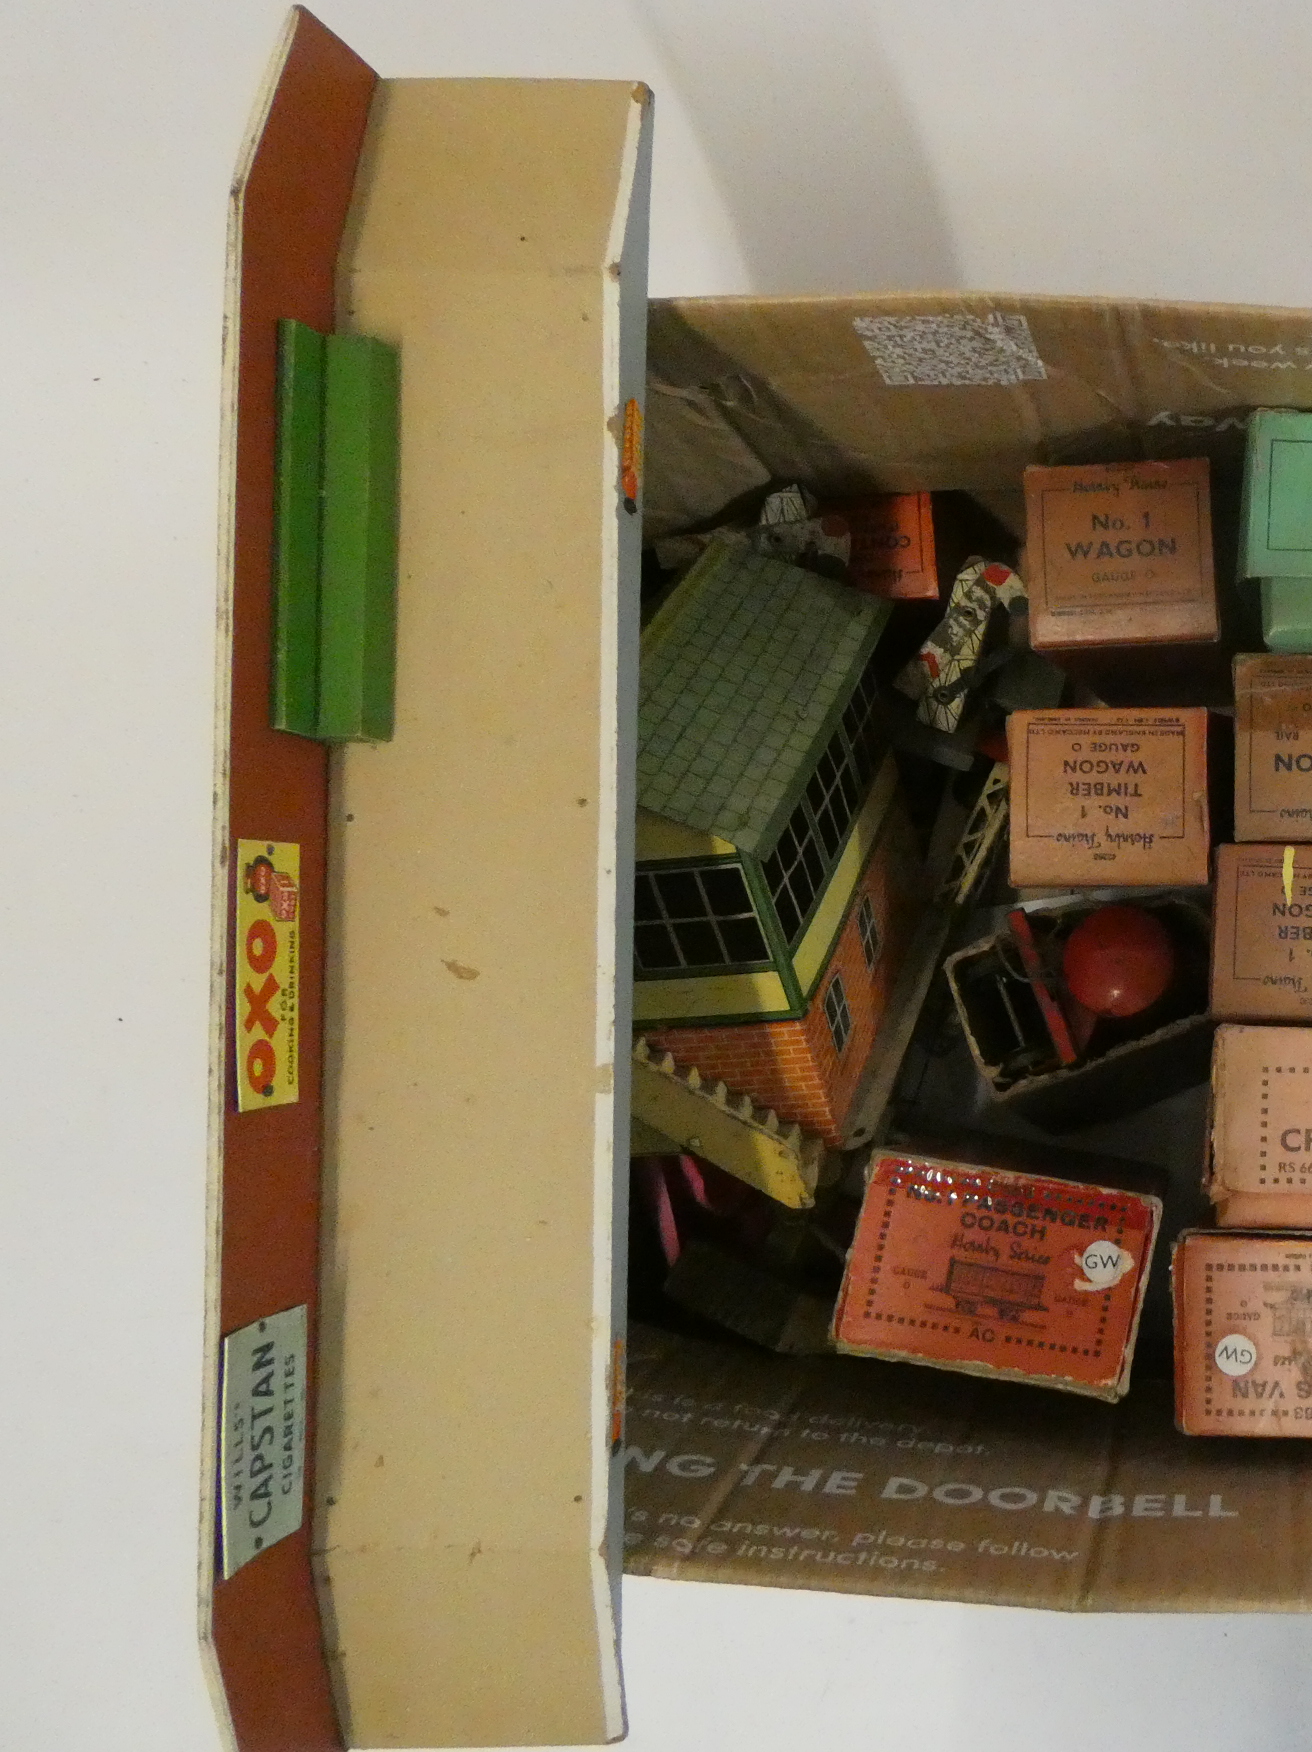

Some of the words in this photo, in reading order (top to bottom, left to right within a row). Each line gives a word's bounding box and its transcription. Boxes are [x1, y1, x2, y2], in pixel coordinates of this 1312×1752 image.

[1152, 339, 1217, 356] like.
[1228, 342, 1285, 358] you
[1205, 357, 1297, 371] week.
[1091, 513, 1131, 531] No.
[1142, 511, 1150, 529] 1
[1064, 537, 1178, 561] WAGON
[1089, 742, 1140, 753] GAUGE
[1063, 759, 1148, 775] WAGON
[1068, 781, 1143, 797] TIMBER
[1080, 805, 1087, 819] 1
[1098, 804, 1130, 820] No.
[1055, 832, 1102, 849] Trains
[1105, 825, 1155, 851] Hornby
[287, 930, 295, 999] DRINKING
[1289, 948, 1296, 963] 1
[1262, 975, 1308, 994] Trains
[244, 919, 280, 1094] OXO
[287, 1017, 295, 1085] COOKING
[1277, 1161, 1296, 1174] RS
[961, 1192, 1110, 1233] PASSENGER
[959, 1211, 1048, 1240] COACH
[1085, 1253, 1120, 1270] GW
[969, 1327, 996, 1343] AC
[1219, 1345, 1253, 1365] GW
[1231, 1379, 1286, 1400] VAN
[281, 1353, 295, 1495] CIGARETTES
[642, 1408, 693, 1425] not
[701, 1417, 790, 1439] return
[801, 1425, 831, 1442] to
[840, 1429, 888, 1449] the
[249, 1341, 275, 1529] CAPSTAN
[739, 1462, 866, 1497] THE
[881, 1476, 1240, 1520] DOORBELL
[658, 1511, 700, 1530] no
[710, 1517, 839, 1546] answer,
[852, 1528, 964, 1554] please
[977, 1538, 1083, 1564] follow
[654, 1532, 725, 1556] safe
[738, 1540, 947, 1575] instructions.
